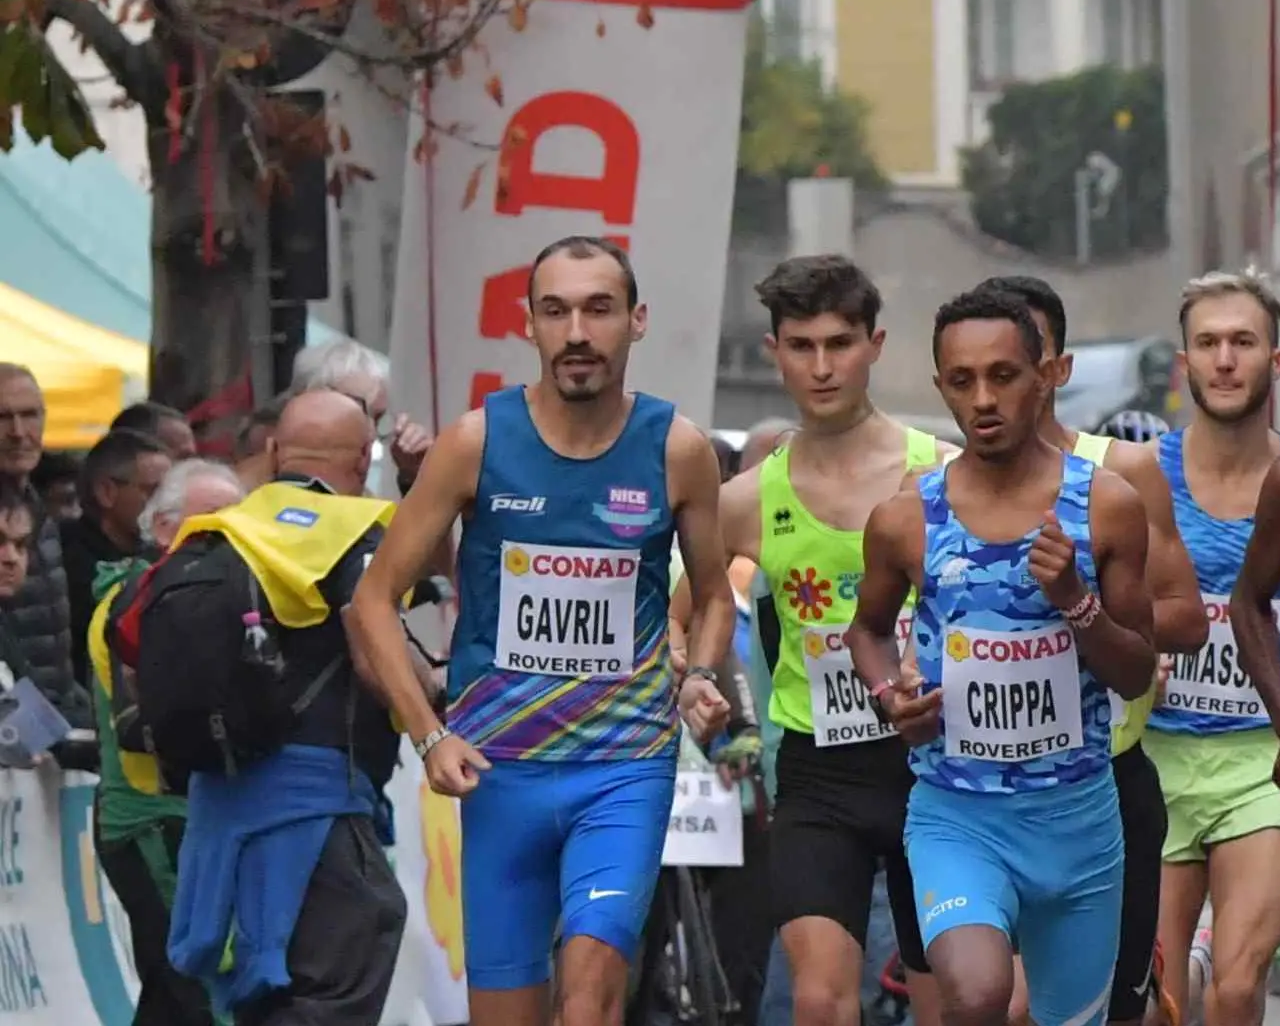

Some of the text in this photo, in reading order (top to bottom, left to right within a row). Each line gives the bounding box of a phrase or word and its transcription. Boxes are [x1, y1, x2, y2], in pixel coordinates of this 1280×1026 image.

[490, 497, 547, 513] poli
[610, 487, 647, 505] NICE
[532, 554, 636, 579] CONAD
[517, 594, 616, 645] GAVRIL
[972, 630, 1072, 662] CONAD
[508, 652, 622, 673] ROVERETO
[824, 669, 876, 715] AGO
[967, 679, 1056, 730] CRIPPA
[1167, 692, 1260, 715] OVERETO
[960, 733, 1071, 759] ROVERETO
